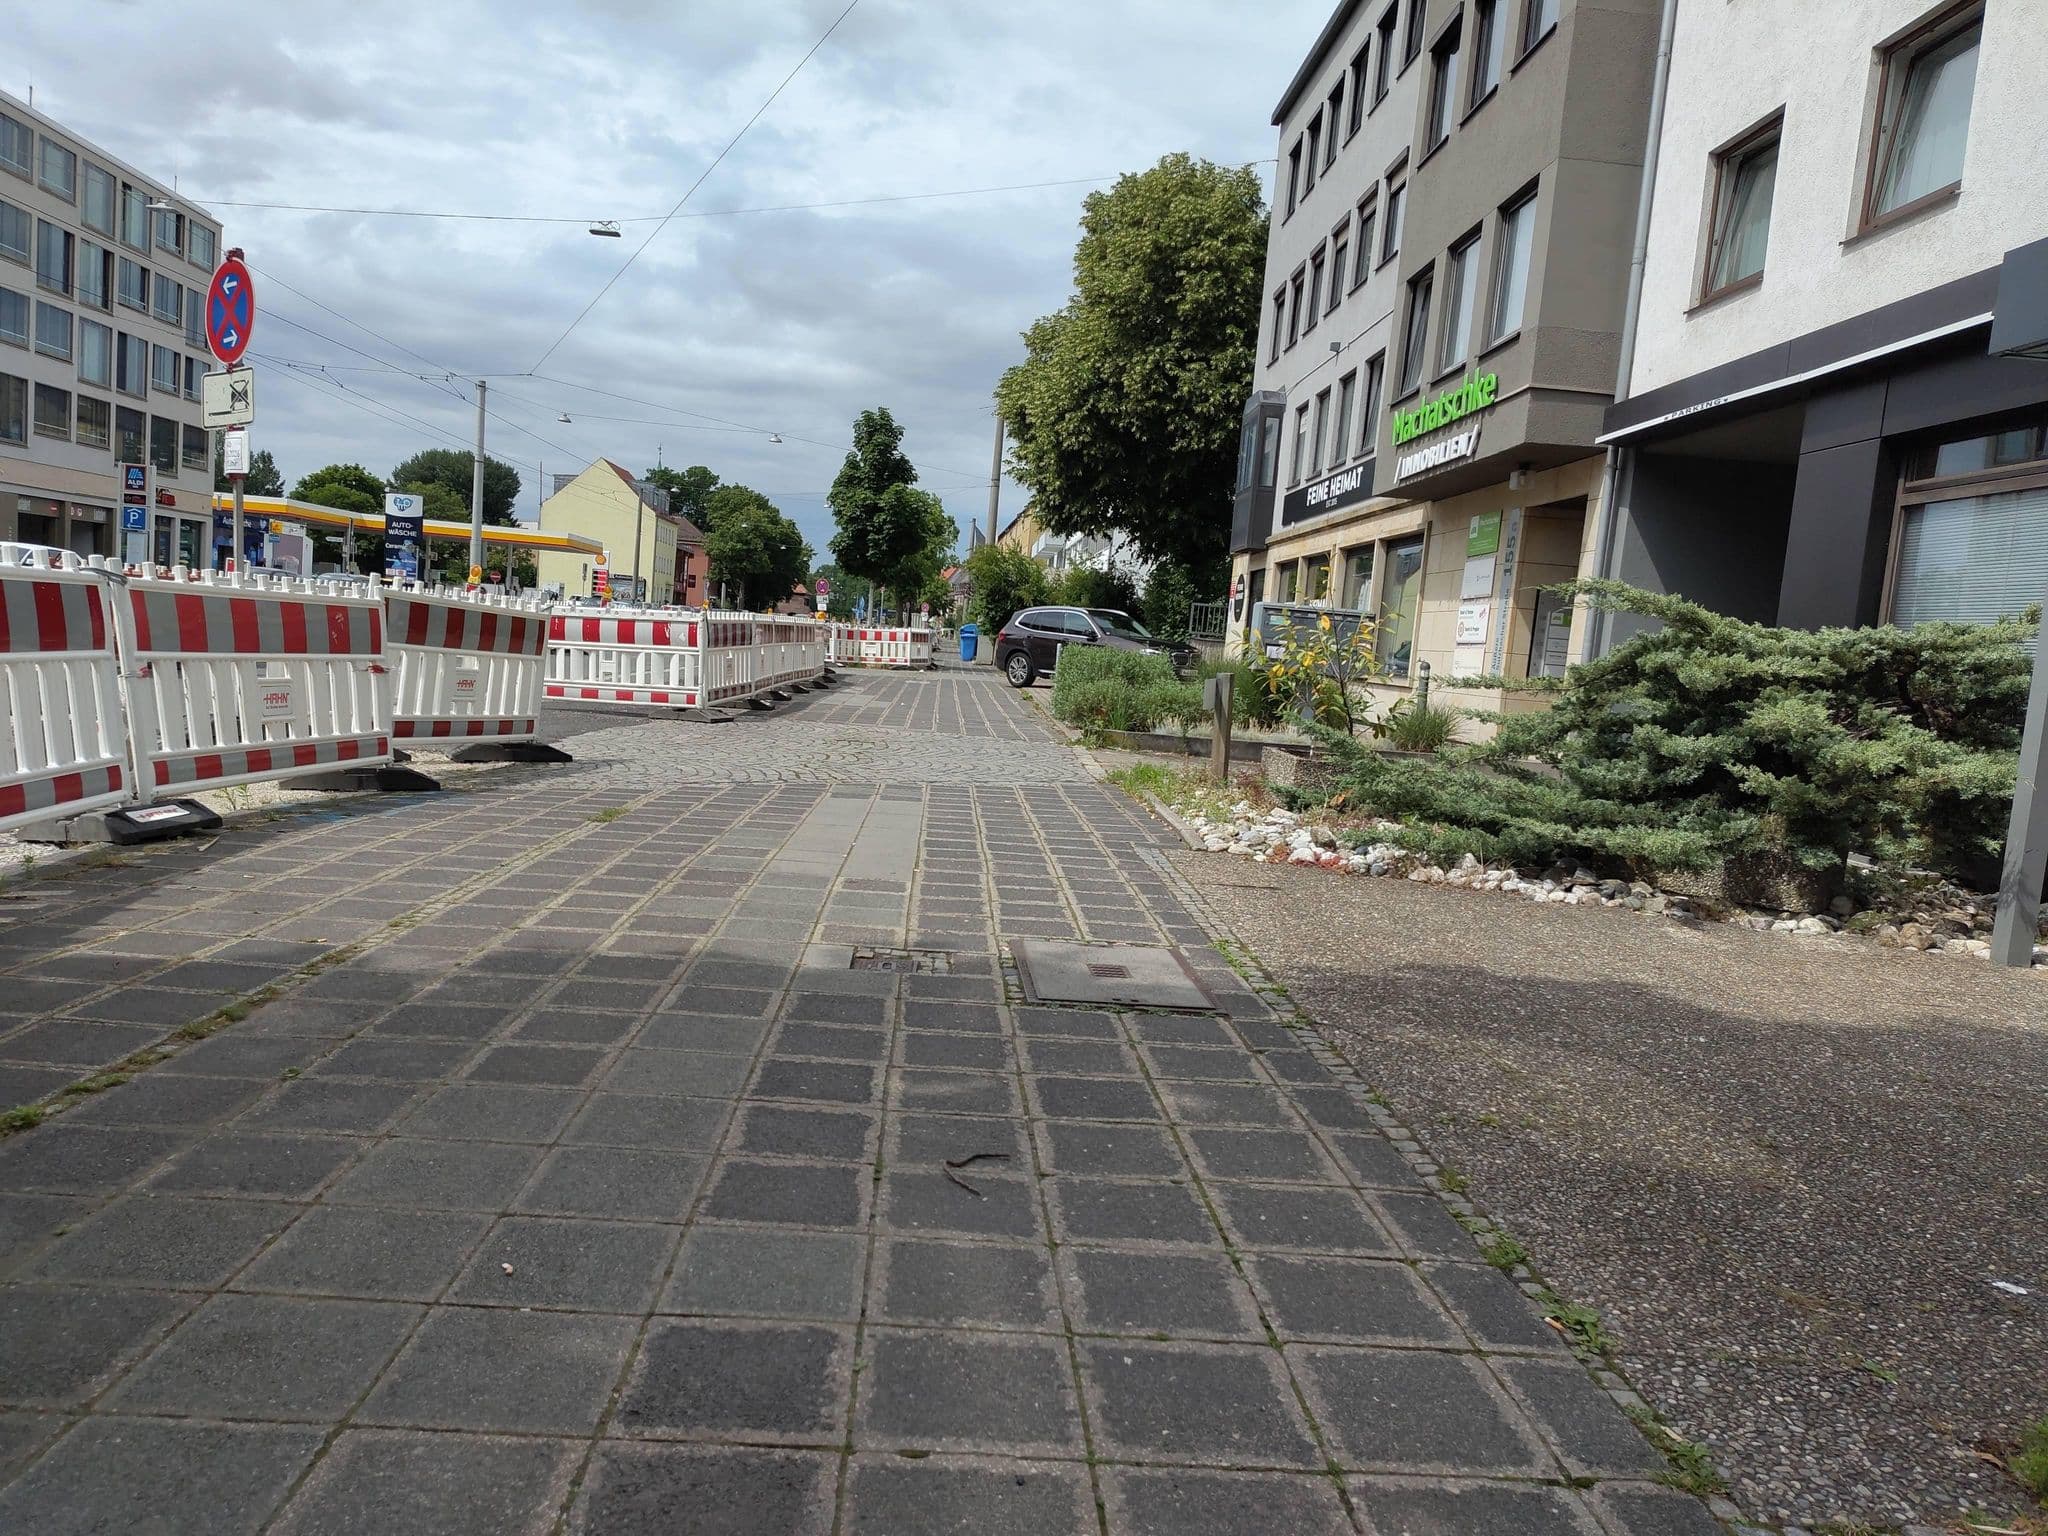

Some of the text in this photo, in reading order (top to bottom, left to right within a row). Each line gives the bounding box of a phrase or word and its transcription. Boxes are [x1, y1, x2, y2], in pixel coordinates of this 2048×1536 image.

[1392, 367, 1498, 447] Machatschke
[1671, 399, 1721, 418] PARKING
[1306, 466, 1364, 507] FEINE HEIMAT
[388, 528, 418, 537] WÄSCHE
[391, 521, 414, 529] AUTO-
[1503, 535, 1516, 577] 155
[263, 692, 290, 704] HAHN
